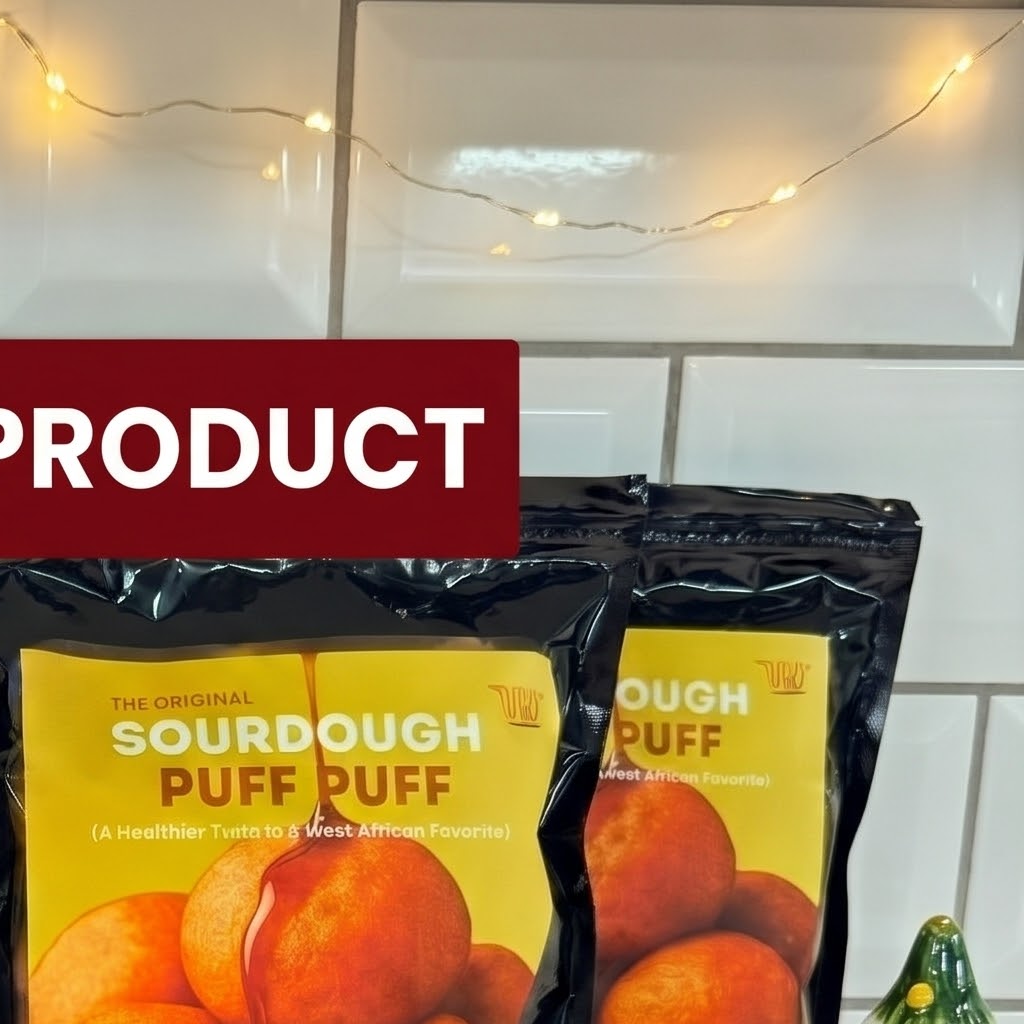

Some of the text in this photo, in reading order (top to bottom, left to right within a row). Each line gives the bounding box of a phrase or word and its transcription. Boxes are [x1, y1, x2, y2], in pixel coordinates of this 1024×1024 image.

[111, 690, 254, 711] THE ORIGINAL
[111, 711, 482, 756] SOURDOUGH
[617, 720, 722, 758] PUFF
[160, 765, 452, 808] PUFF PUFF
[92, 823, 112, 842] (A
[117, 823, 206, 840] Healthier
[264, 824, 283, 839] to
[305, 823, 353, 838] West
[358, 822, 425, 838] African
[430, 823, 511, 841] Favorite)
